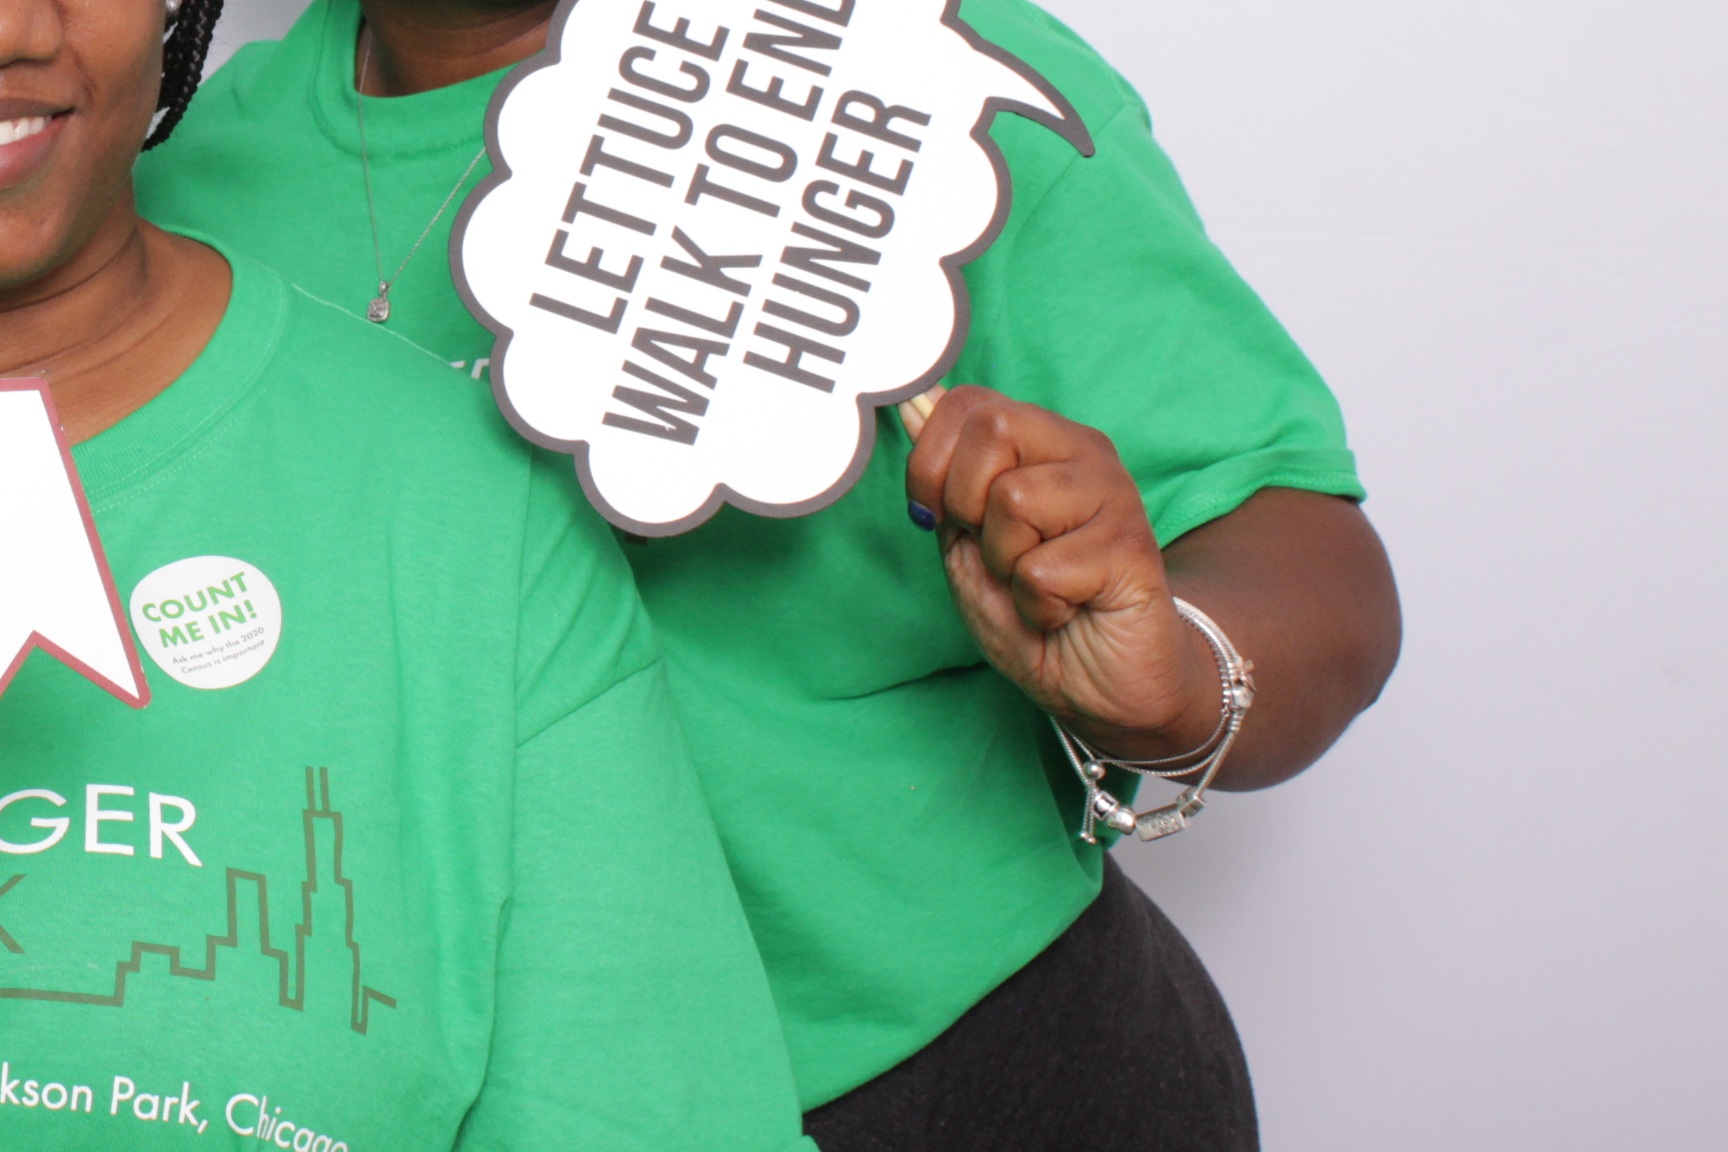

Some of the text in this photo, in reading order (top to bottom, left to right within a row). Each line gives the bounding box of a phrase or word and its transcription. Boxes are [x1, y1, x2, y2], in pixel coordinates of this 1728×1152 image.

[529, 0, 730, 335] LETTUCE
[742, 88, 932, 394] HUNGER
[602, 224, 763, 446] WALK
[683, 122, 799, 219] TO
[141, 571, 248, 623] COUNT
[158, 599, 257, 649] ME IN!
[172, 626, 265, 665] Ask me why the 2020
[181, 639, 265, 675] Census is important
[109, 1074, 209, 1135] Park,
